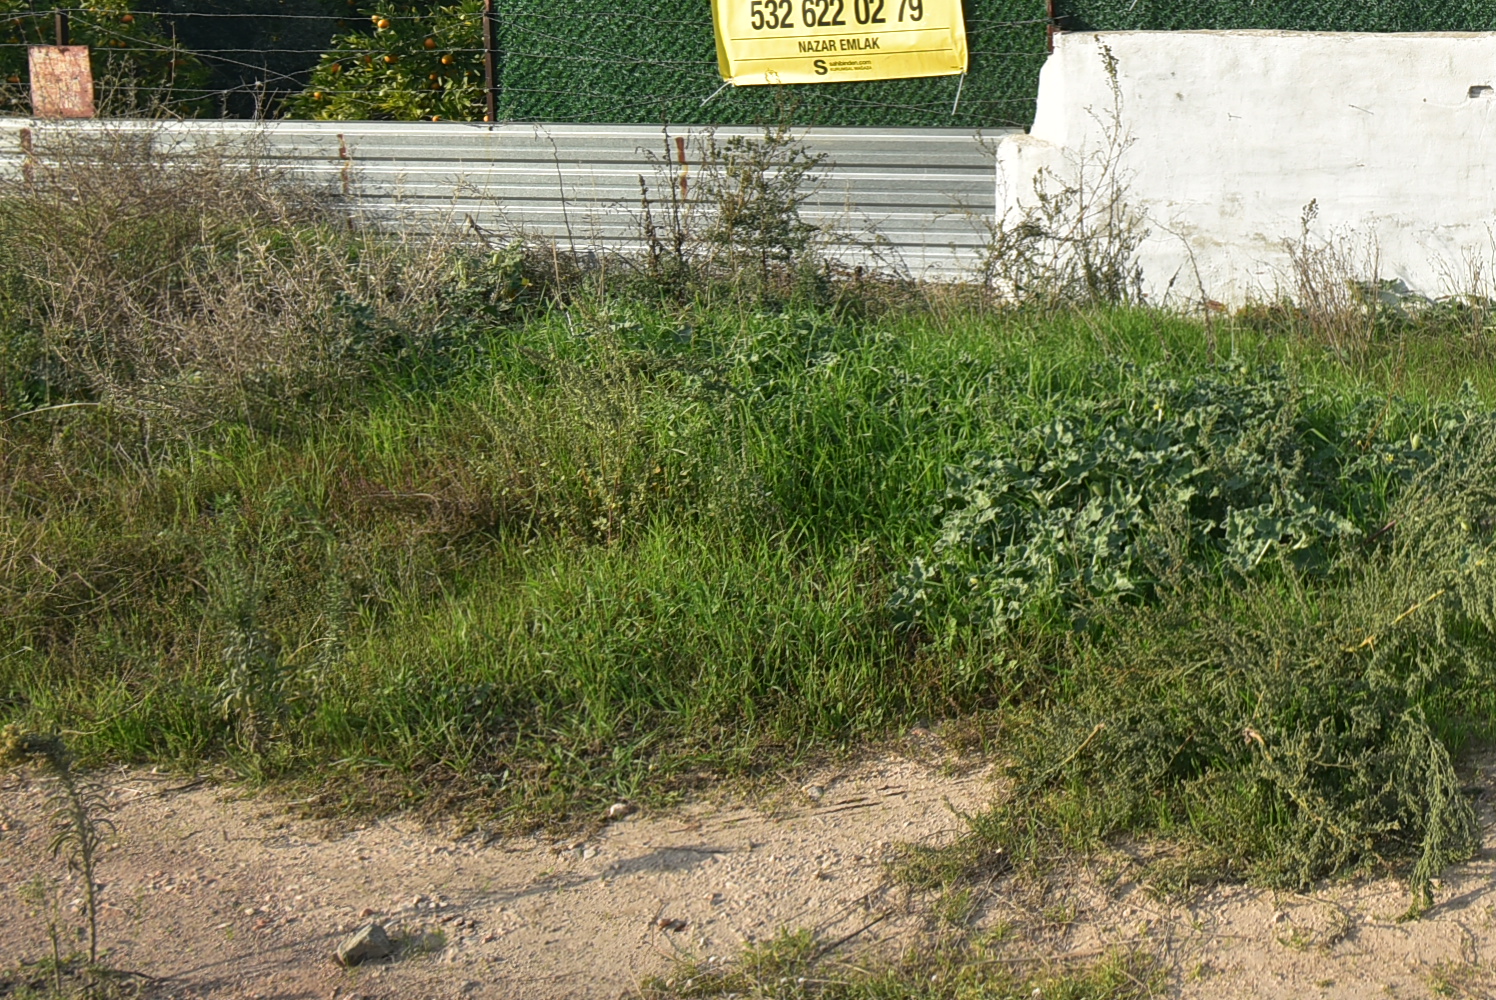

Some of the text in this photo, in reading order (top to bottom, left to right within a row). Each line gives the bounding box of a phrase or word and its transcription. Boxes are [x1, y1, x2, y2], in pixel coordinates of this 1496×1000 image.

[751, 0, 794, 30] 532
[798, 37, 880, 53] NAZAR EMLAK
[813, 59, 828, 75] S
